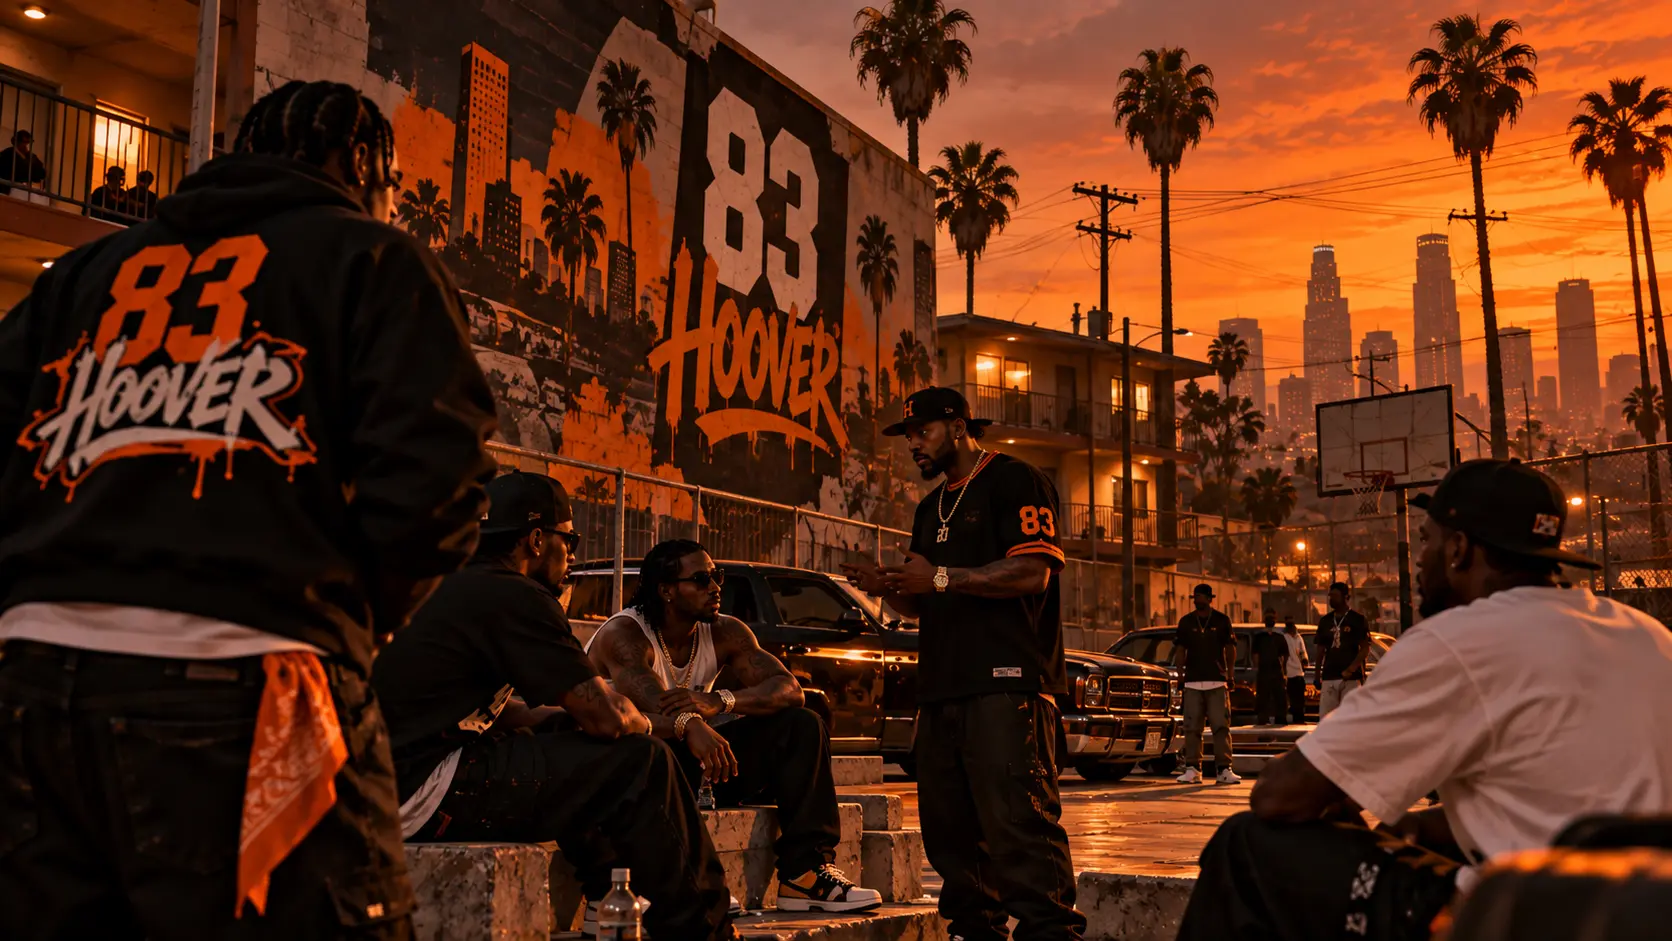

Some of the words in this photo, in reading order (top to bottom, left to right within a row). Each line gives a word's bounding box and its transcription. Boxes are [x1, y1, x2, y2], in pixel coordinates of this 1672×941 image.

[703, 87, 819, 321] 83
[93, 234, 269, 366] 83
[648, 237, 849, 453] HOOVER
[36, 336, 301, 470] HOOVER
[903, 400, 914, 418] H
[1019, 505, 1055, 537] 83
